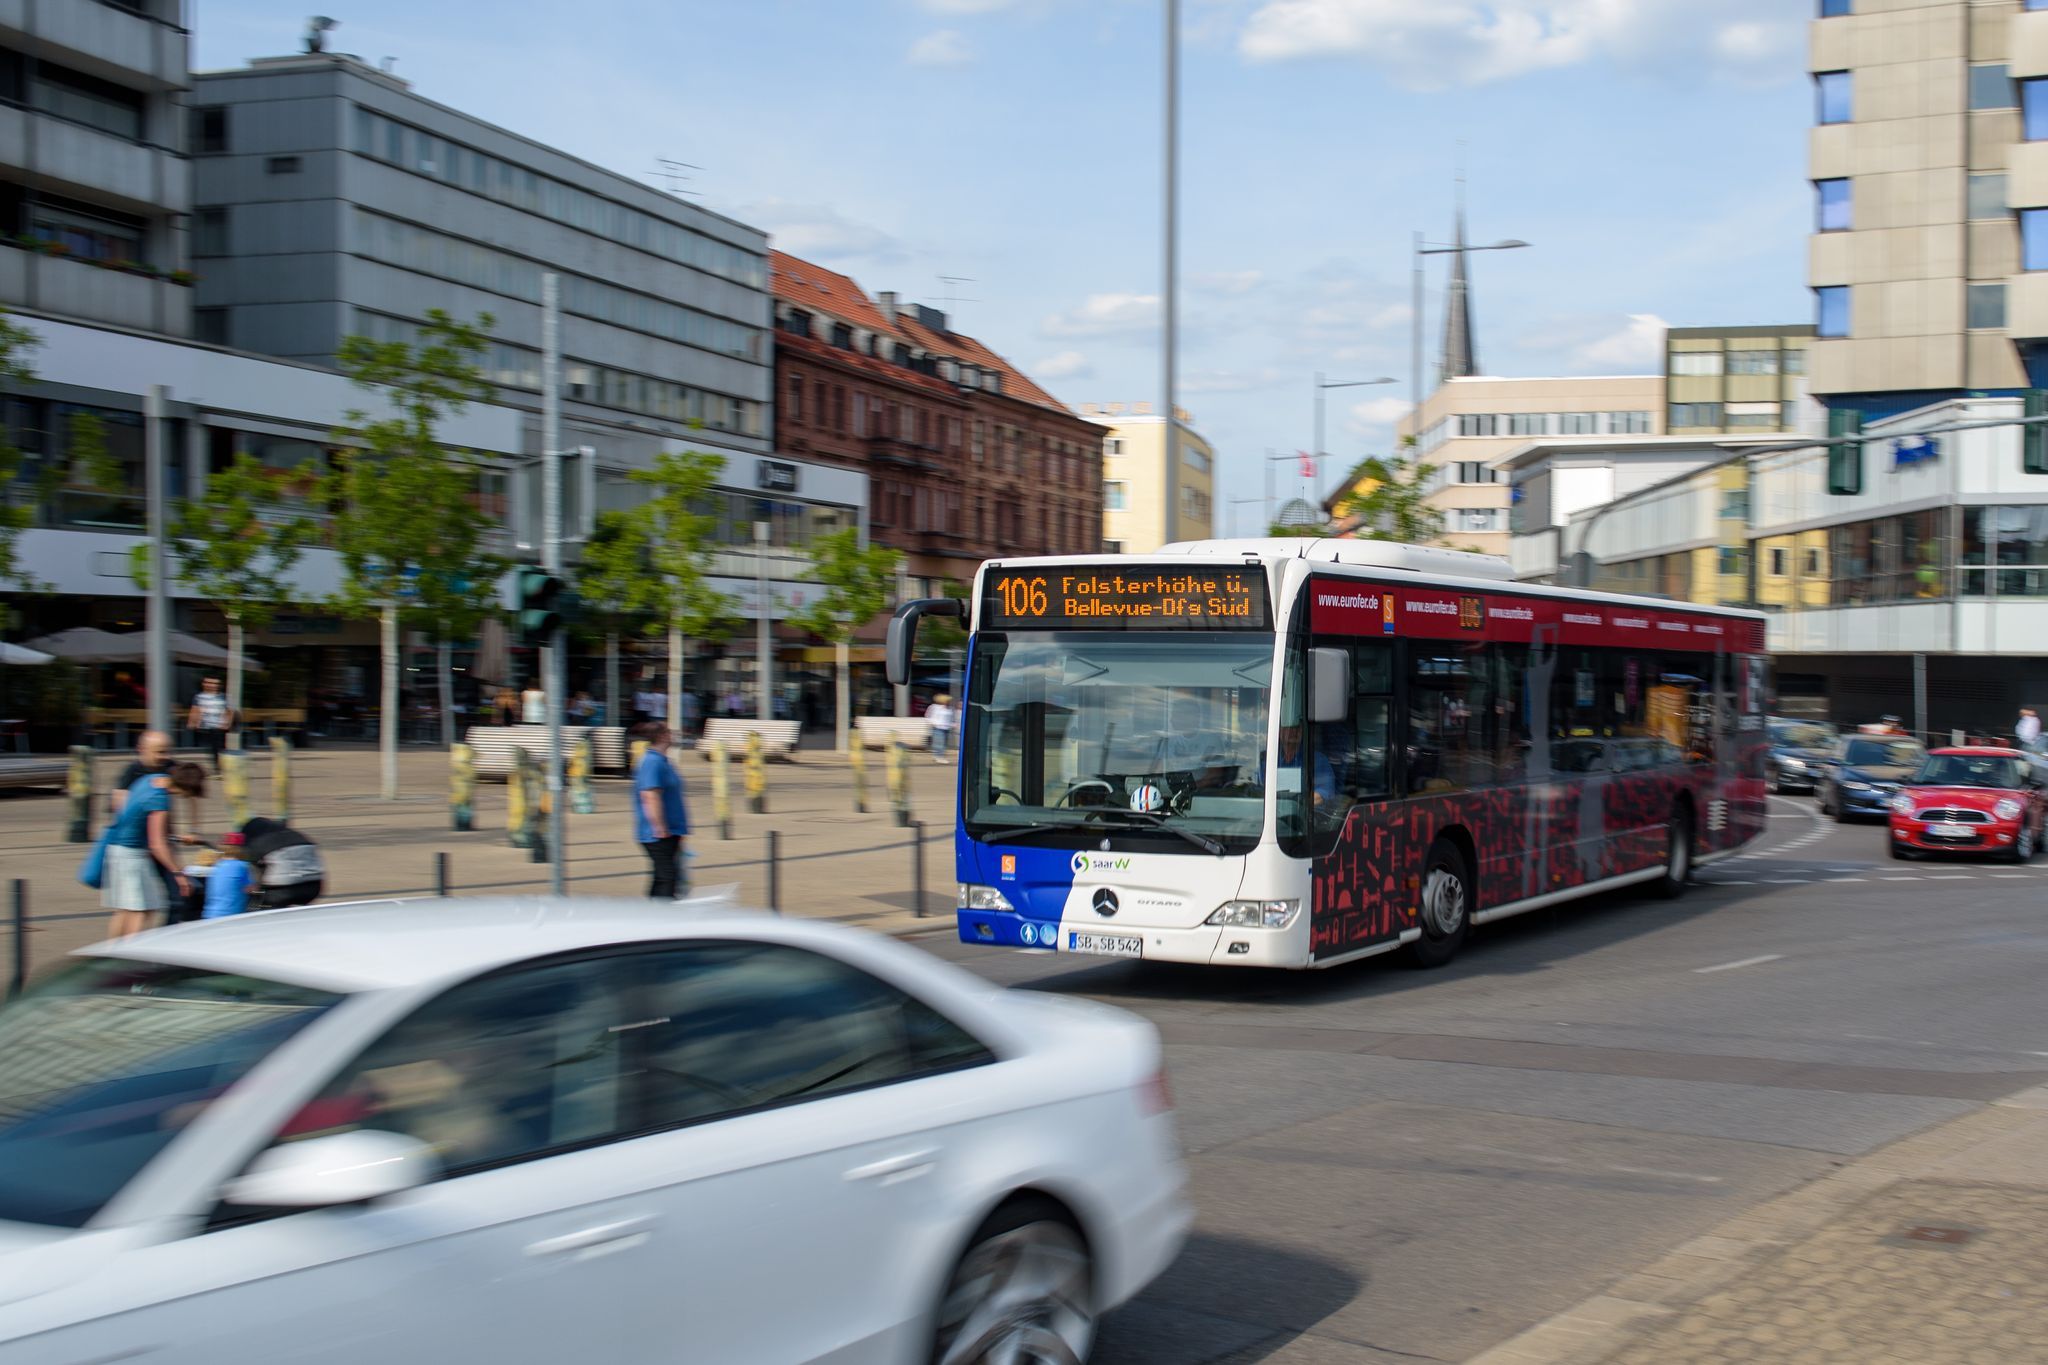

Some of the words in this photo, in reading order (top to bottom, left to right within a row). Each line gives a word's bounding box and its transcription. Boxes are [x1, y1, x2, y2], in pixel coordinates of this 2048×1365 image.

[1062, 575, 1216, 594] Folsterhöhe
[1226, 575, 1249, 593] ü.
[997, 577, 1047, 616] 106
[1318, 593, 1379, 610] www.eurofer.de
[1064, 597, 1201, 616] Bellevue-Dfg
[1208, 597, 1249, 616] Süd
[1078, 936, 1092, 949] SB
[1100, 937, 1115, 951] SB
[1118, 938, 1140, 953] 542
